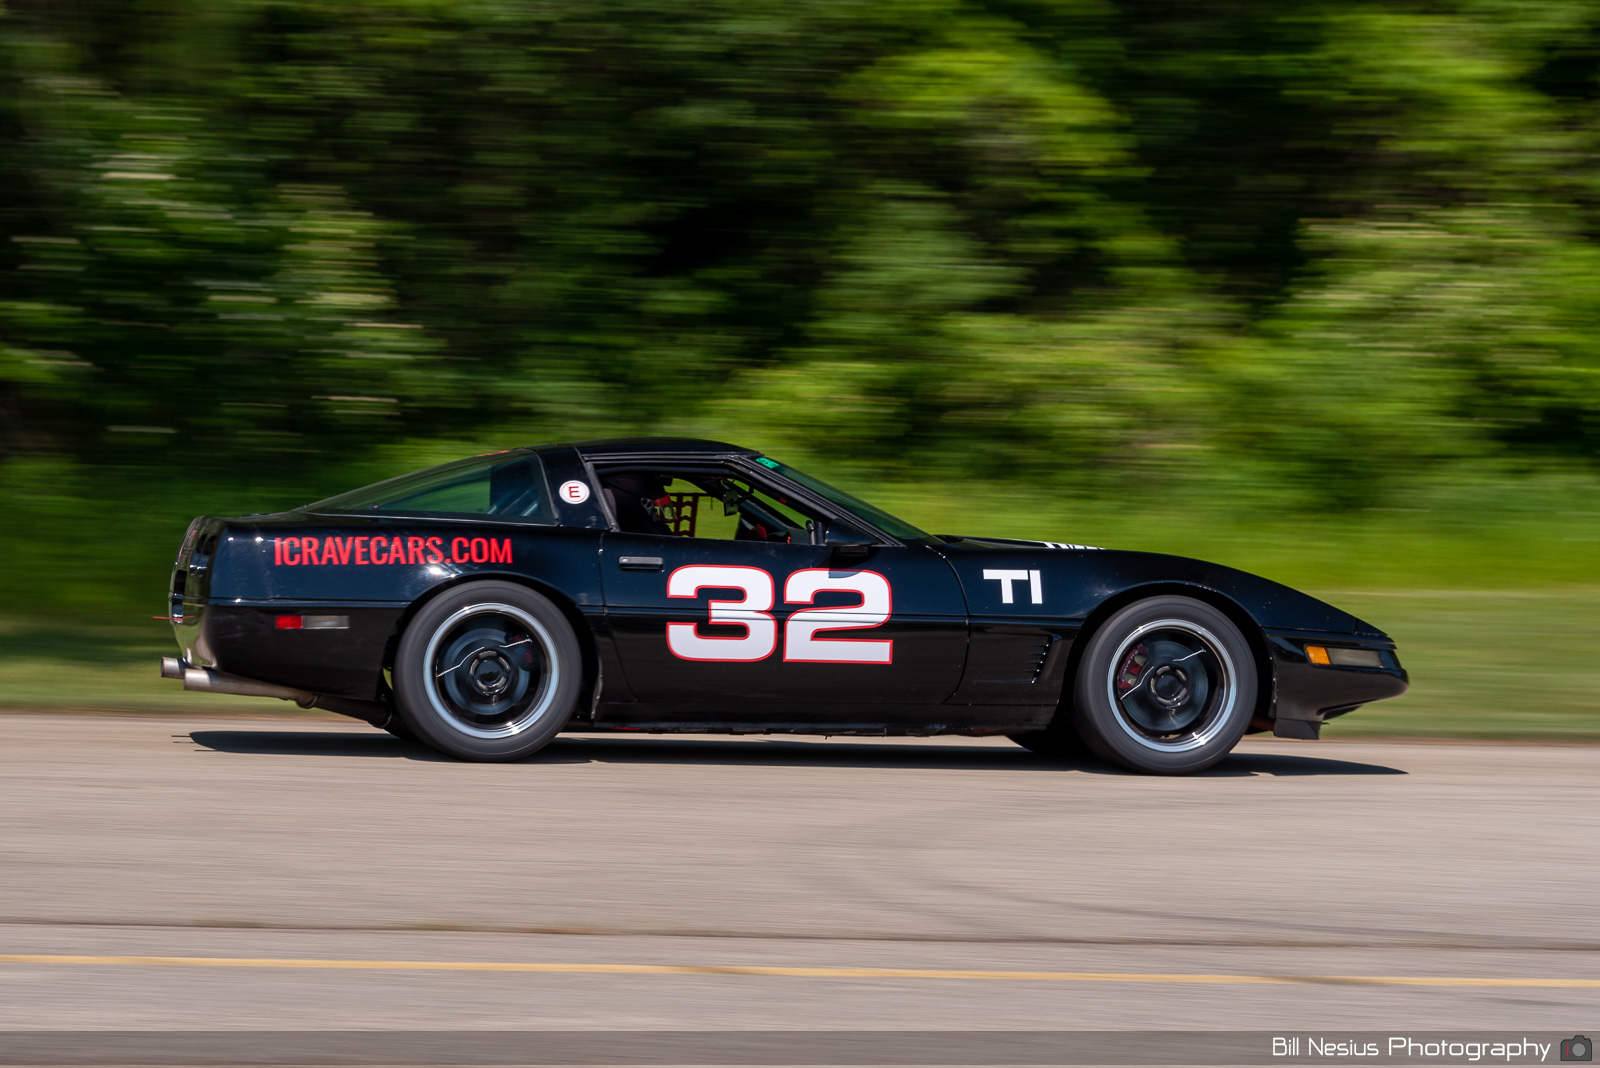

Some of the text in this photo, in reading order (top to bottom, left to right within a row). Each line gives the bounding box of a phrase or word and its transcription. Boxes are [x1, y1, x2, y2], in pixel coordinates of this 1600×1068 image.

[568, 485, 581, 498] E
[274, 536, 513, 567] ICRAVECARS.COM
[982, 569, 1043, 605] TI
[666, 564, 893, 665] 32
